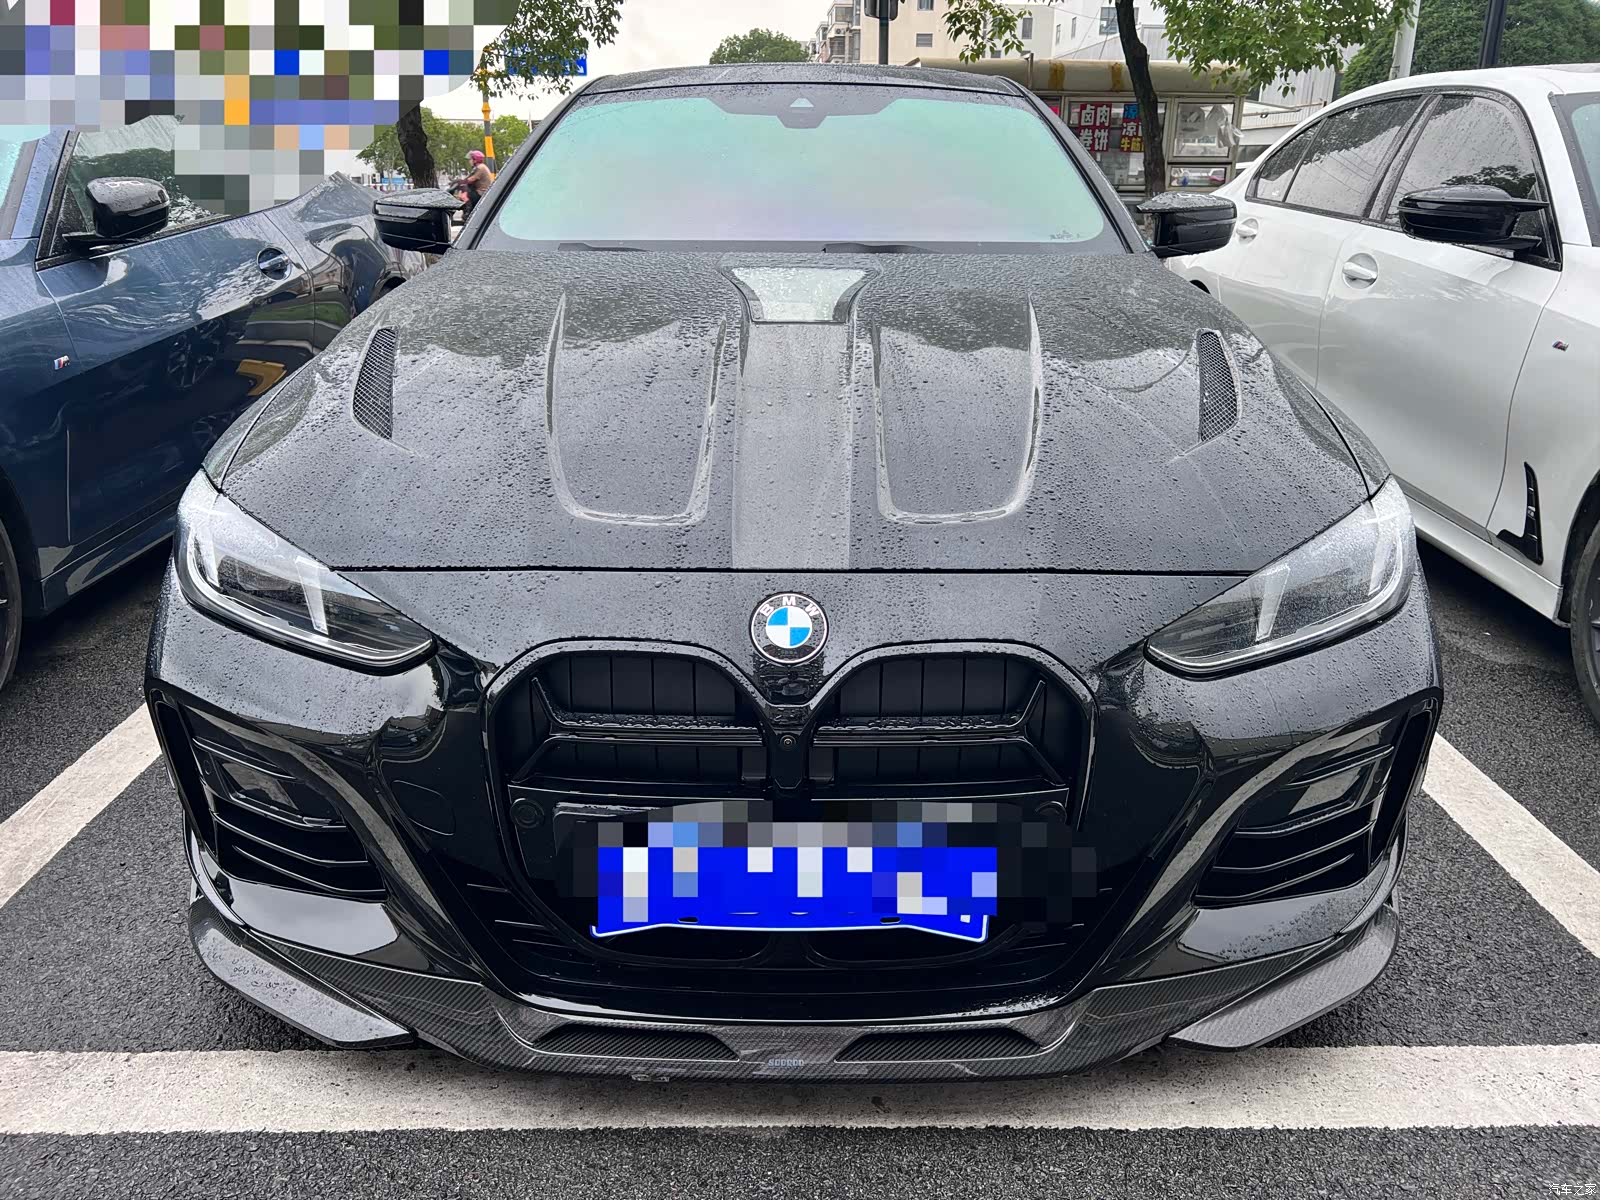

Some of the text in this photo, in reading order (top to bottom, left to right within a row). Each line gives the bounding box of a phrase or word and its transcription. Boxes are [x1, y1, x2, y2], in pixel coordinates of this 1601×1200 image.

[1081, 104, 1110, 126] 卤肉
[1080, 128, 1108, 150] 卷饼
[1122, 122, 1143, 136] 凉
[760, 596, 820, 617] BMW
